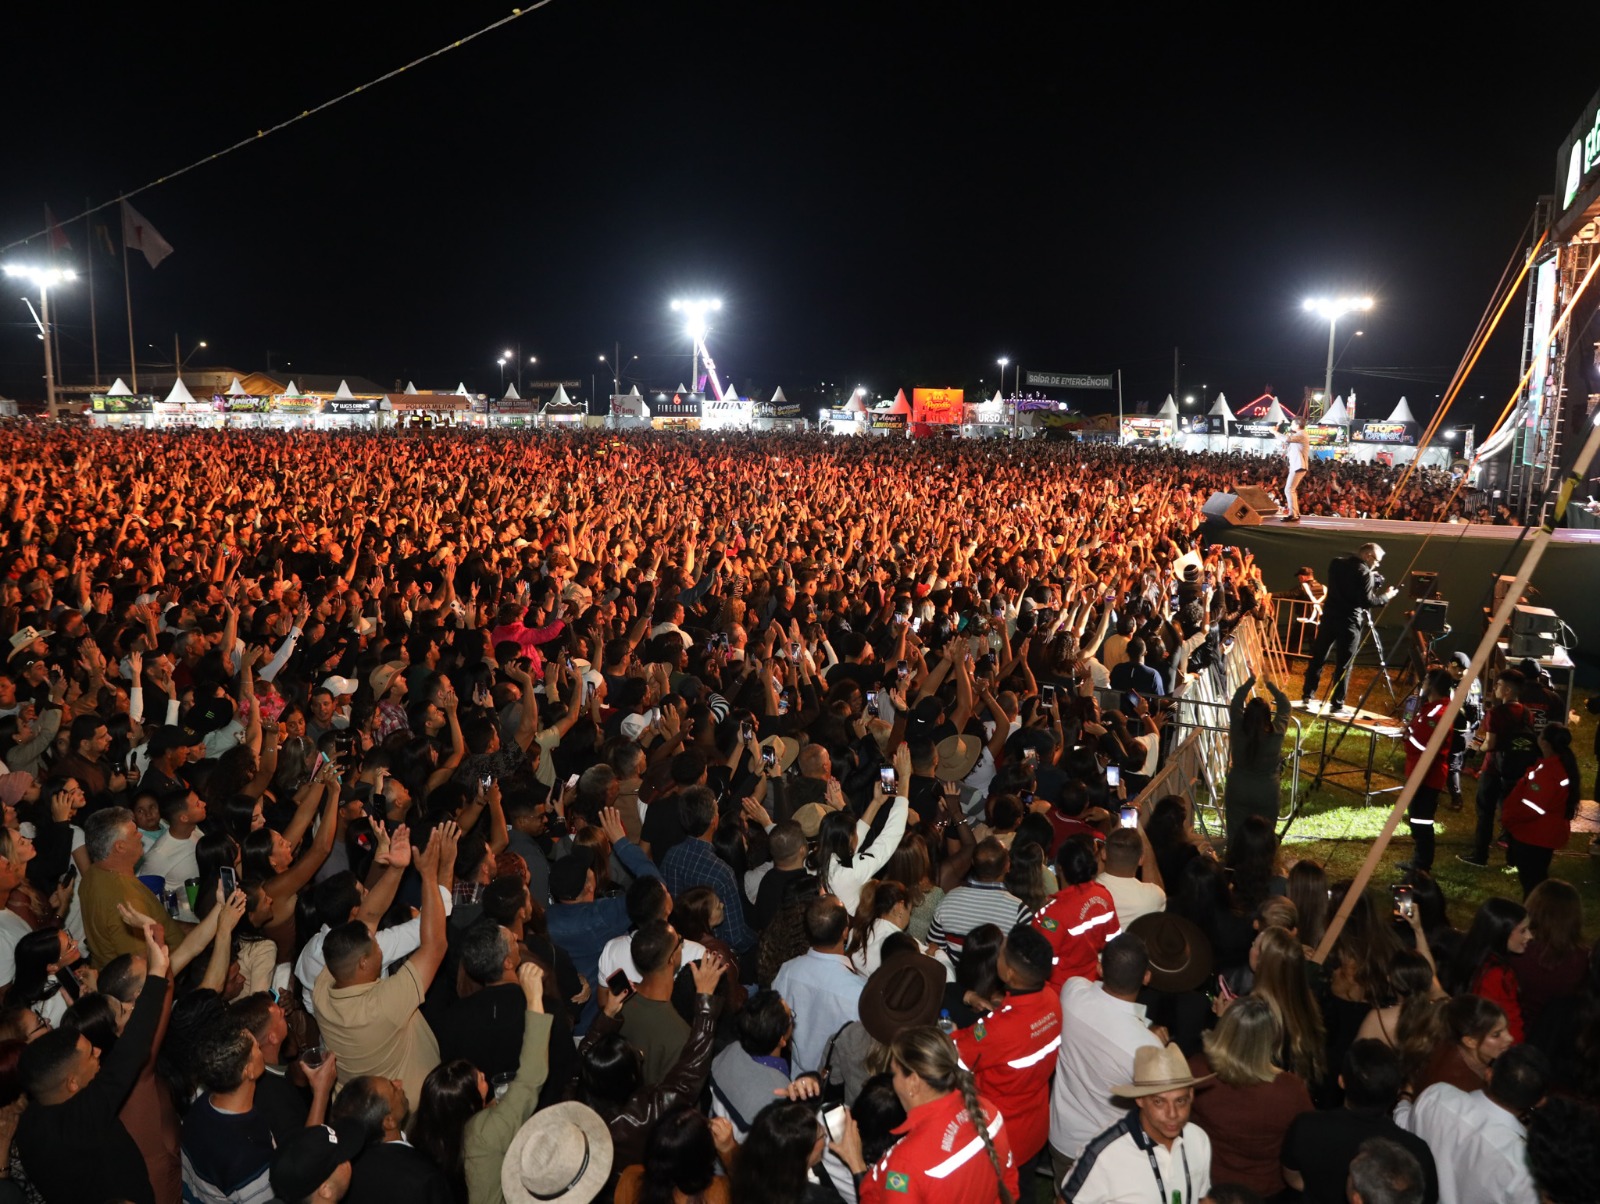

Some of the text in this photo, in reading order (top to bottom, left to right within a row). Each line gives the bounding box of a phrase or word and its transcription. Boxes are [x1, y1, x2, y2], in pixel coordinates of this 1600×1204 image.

[1029, 373, 1049, 383] SAÍDA
[1061, 377, 1109, 386] EMERGÊNCIA
[223, 398, 259, 407] JUNIOR
[979, 414, 1000, 422] URSO
[941, 1120, 960, 1153] BRIGADA
